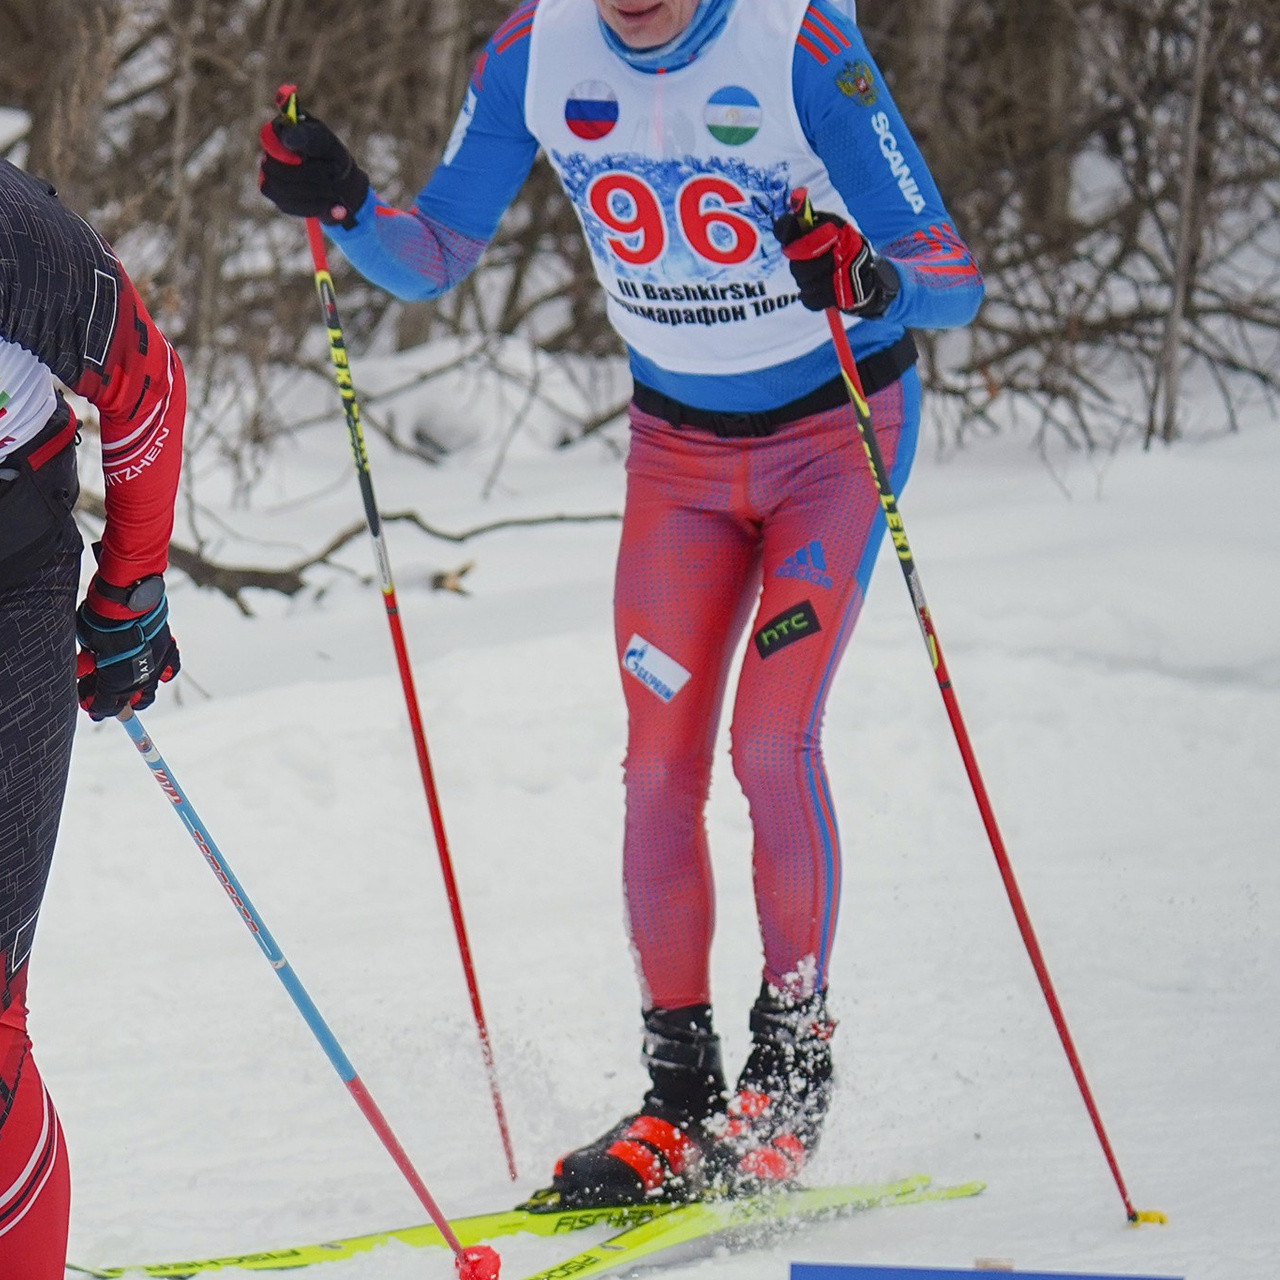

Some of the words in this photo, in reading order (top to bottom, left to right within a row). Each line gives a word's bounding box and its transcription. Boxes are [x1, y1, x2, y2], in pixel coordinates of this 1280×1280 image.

[871, 110, 927, 215] SCANIA
[587, 171, 759, 267] 96
[617, 278, 640, 299] III
[641, 280, 766, 302] BashkirSki
[327, 327, 356, 400] LEKI
[879, 493, 913, 561] LEKI
[773, 563, 834, 591] adidas
